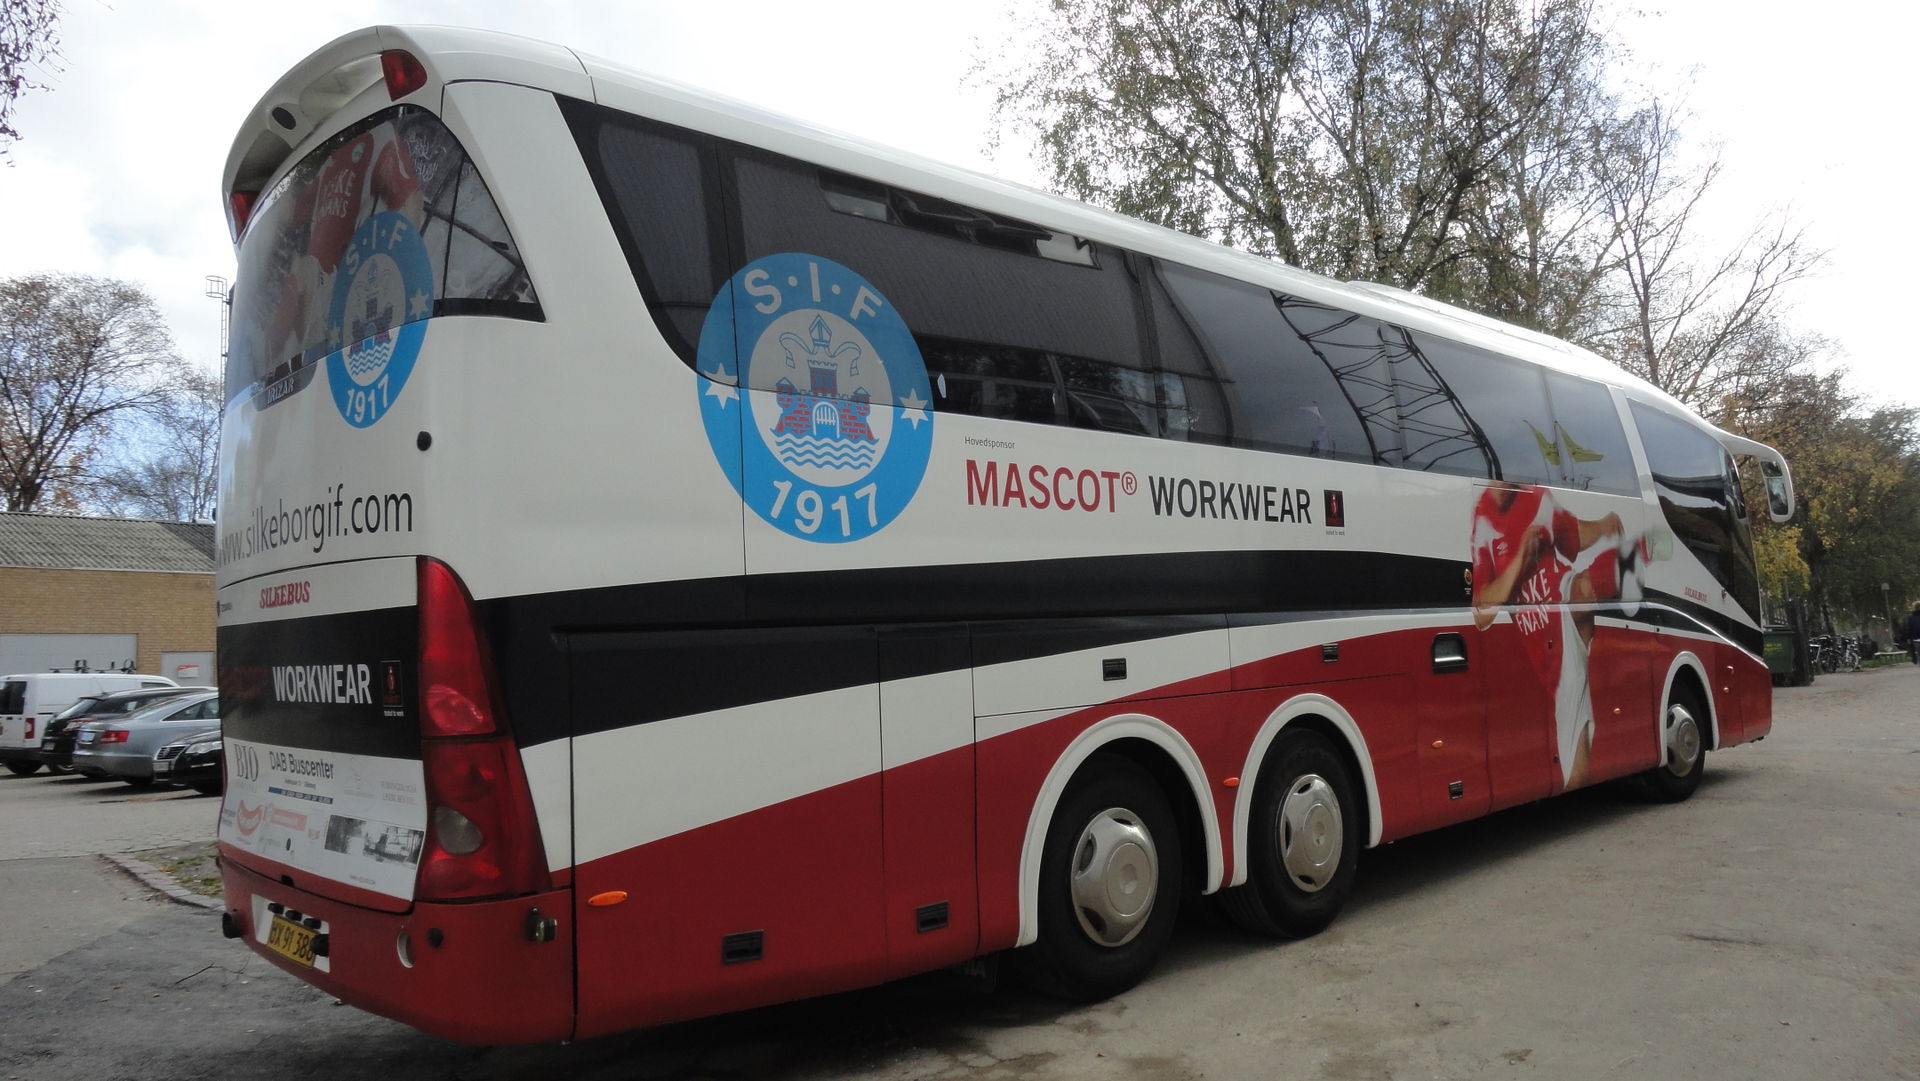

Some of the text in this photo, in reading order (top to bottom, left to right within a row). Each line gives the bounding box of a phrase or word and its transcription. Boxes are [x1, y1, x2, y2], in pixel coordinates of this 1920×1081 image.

[266, 377, 295, 404] IRIZAR
[346, 373, 391, 423] 1917
[964, 436, 1016, 450] Hovedsponsor
[769, 478, 880, 538] 1917
[1148, 475, 1312, 525] WORKWEAR
[259, 580, 311, 609] SILKEBUS
[271, 663, 373, 705] WORKWEAR
[234, 743, 260, 783] BIO
[268, 750, 335, 780] DAB Buscenter
